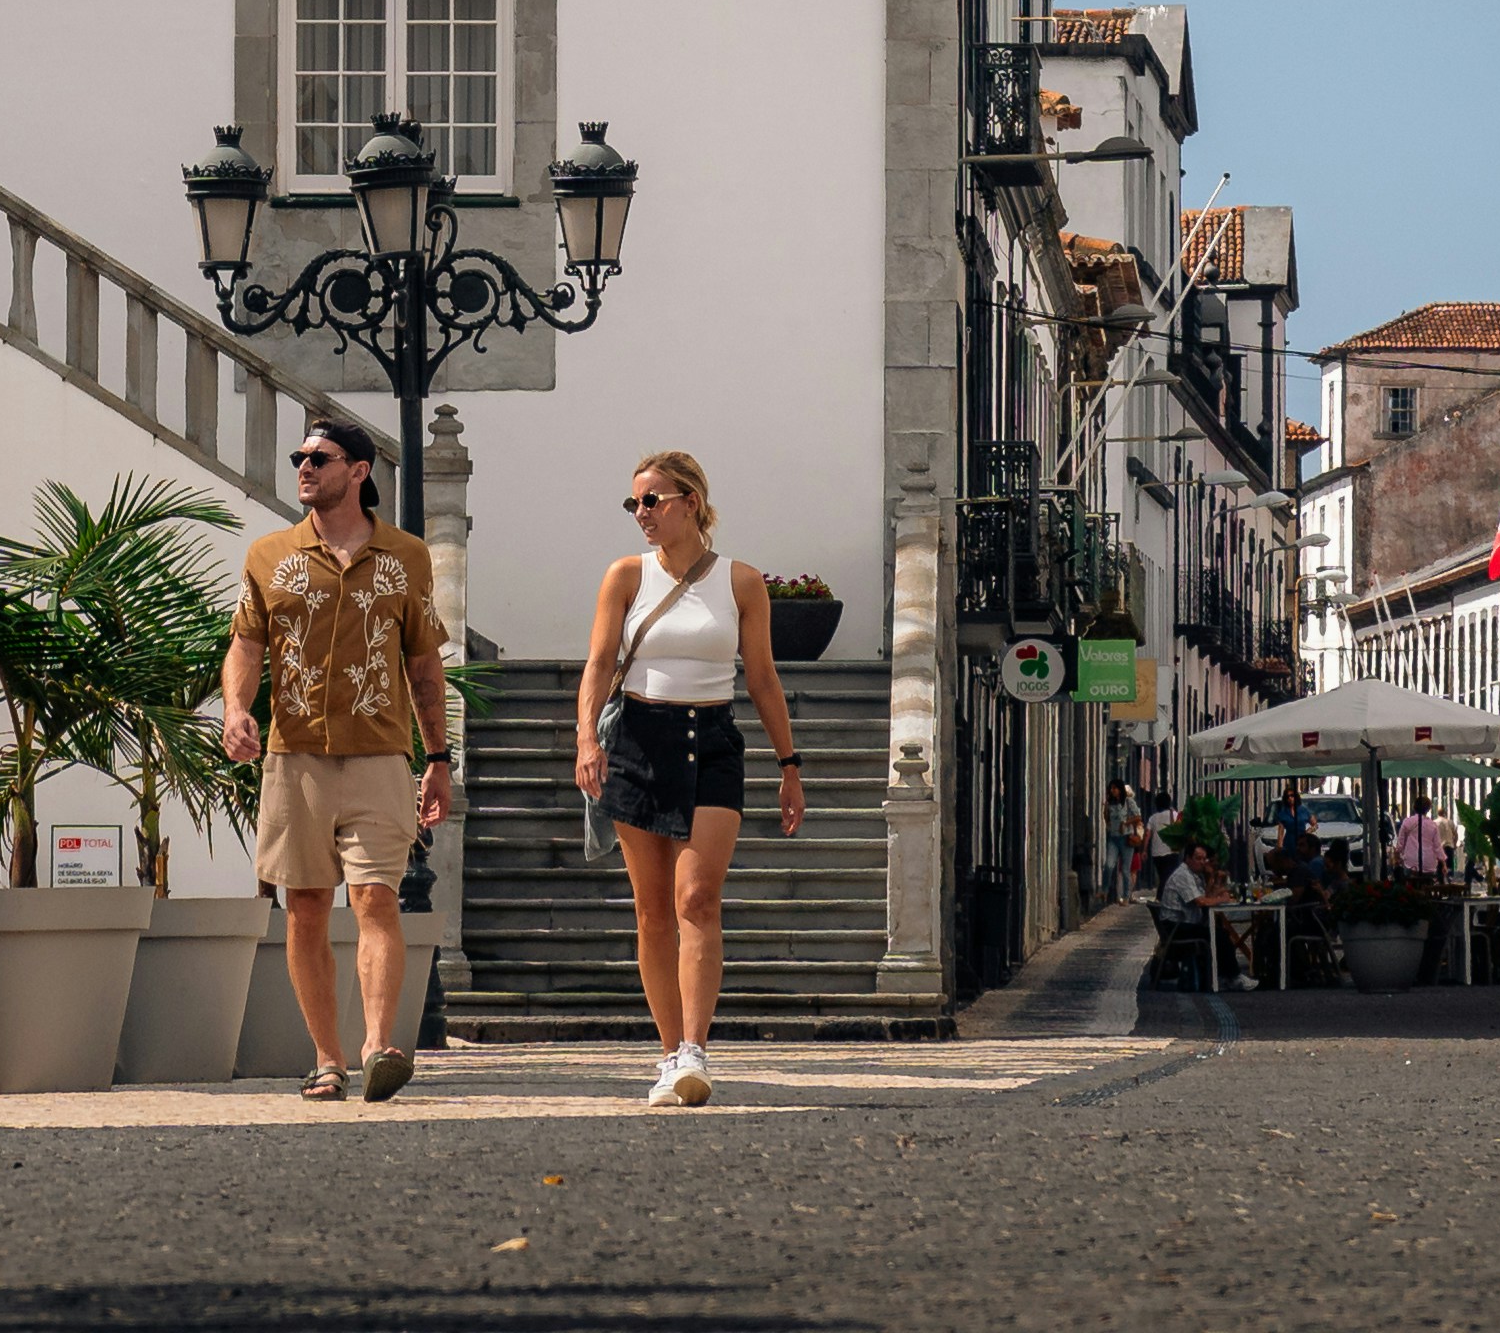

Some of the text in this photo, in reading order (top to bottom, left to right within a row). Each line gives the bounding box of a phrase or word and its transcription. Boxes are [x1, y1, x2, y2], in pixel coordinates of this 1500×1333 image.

[1079, 644, 1129, 662] Valores
[1016, 681, 1050, 694] JOGOS
[1090, 685, 1129, 696] OURO
[60, 839, 113, 848] PDL TOTAL
